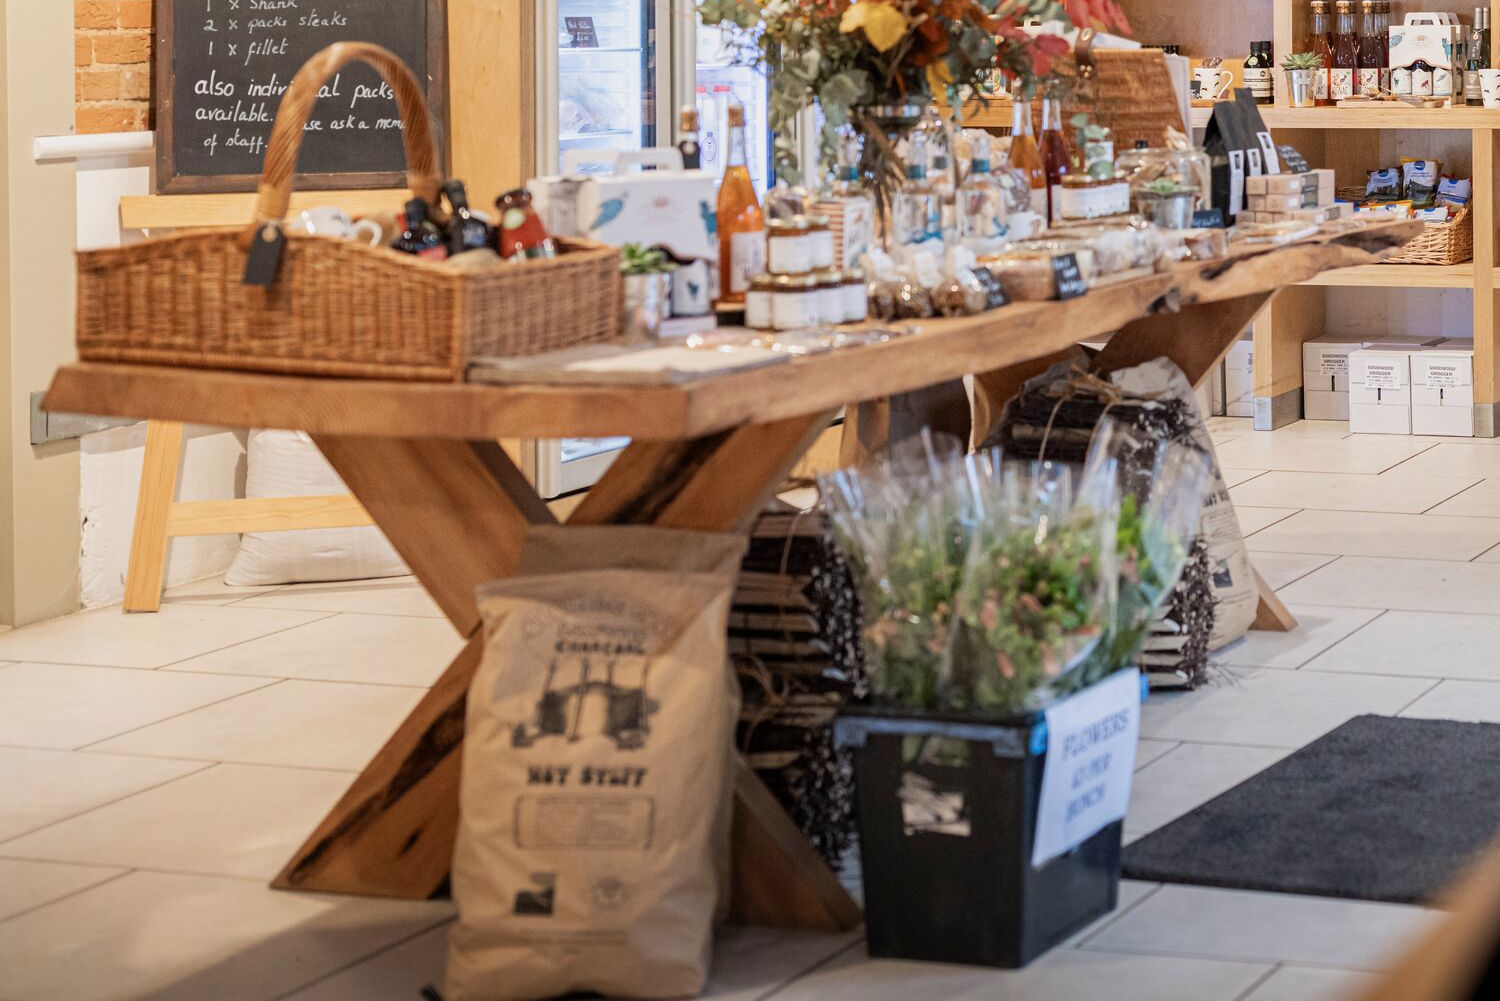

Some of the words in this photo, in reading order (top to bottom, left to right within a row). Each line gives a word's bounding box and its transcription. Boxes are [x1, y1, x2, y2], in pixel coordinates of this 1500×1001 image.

[203, 18, 218, 32] 2
[247, 16, 287, 34] packs
[298, 12, 348, 27] steaks
[244, 38, 287, 66] fillet
[194, 69, 235, 97] also
[350, 81, 394, 109] packs
[195, 100, 273, 122] available.
[330, 114, 355, 130] ask
[358, 119, 369, 130] a
[204, 134, 217, 156] of
[225, 128, 268, 154] staff.
